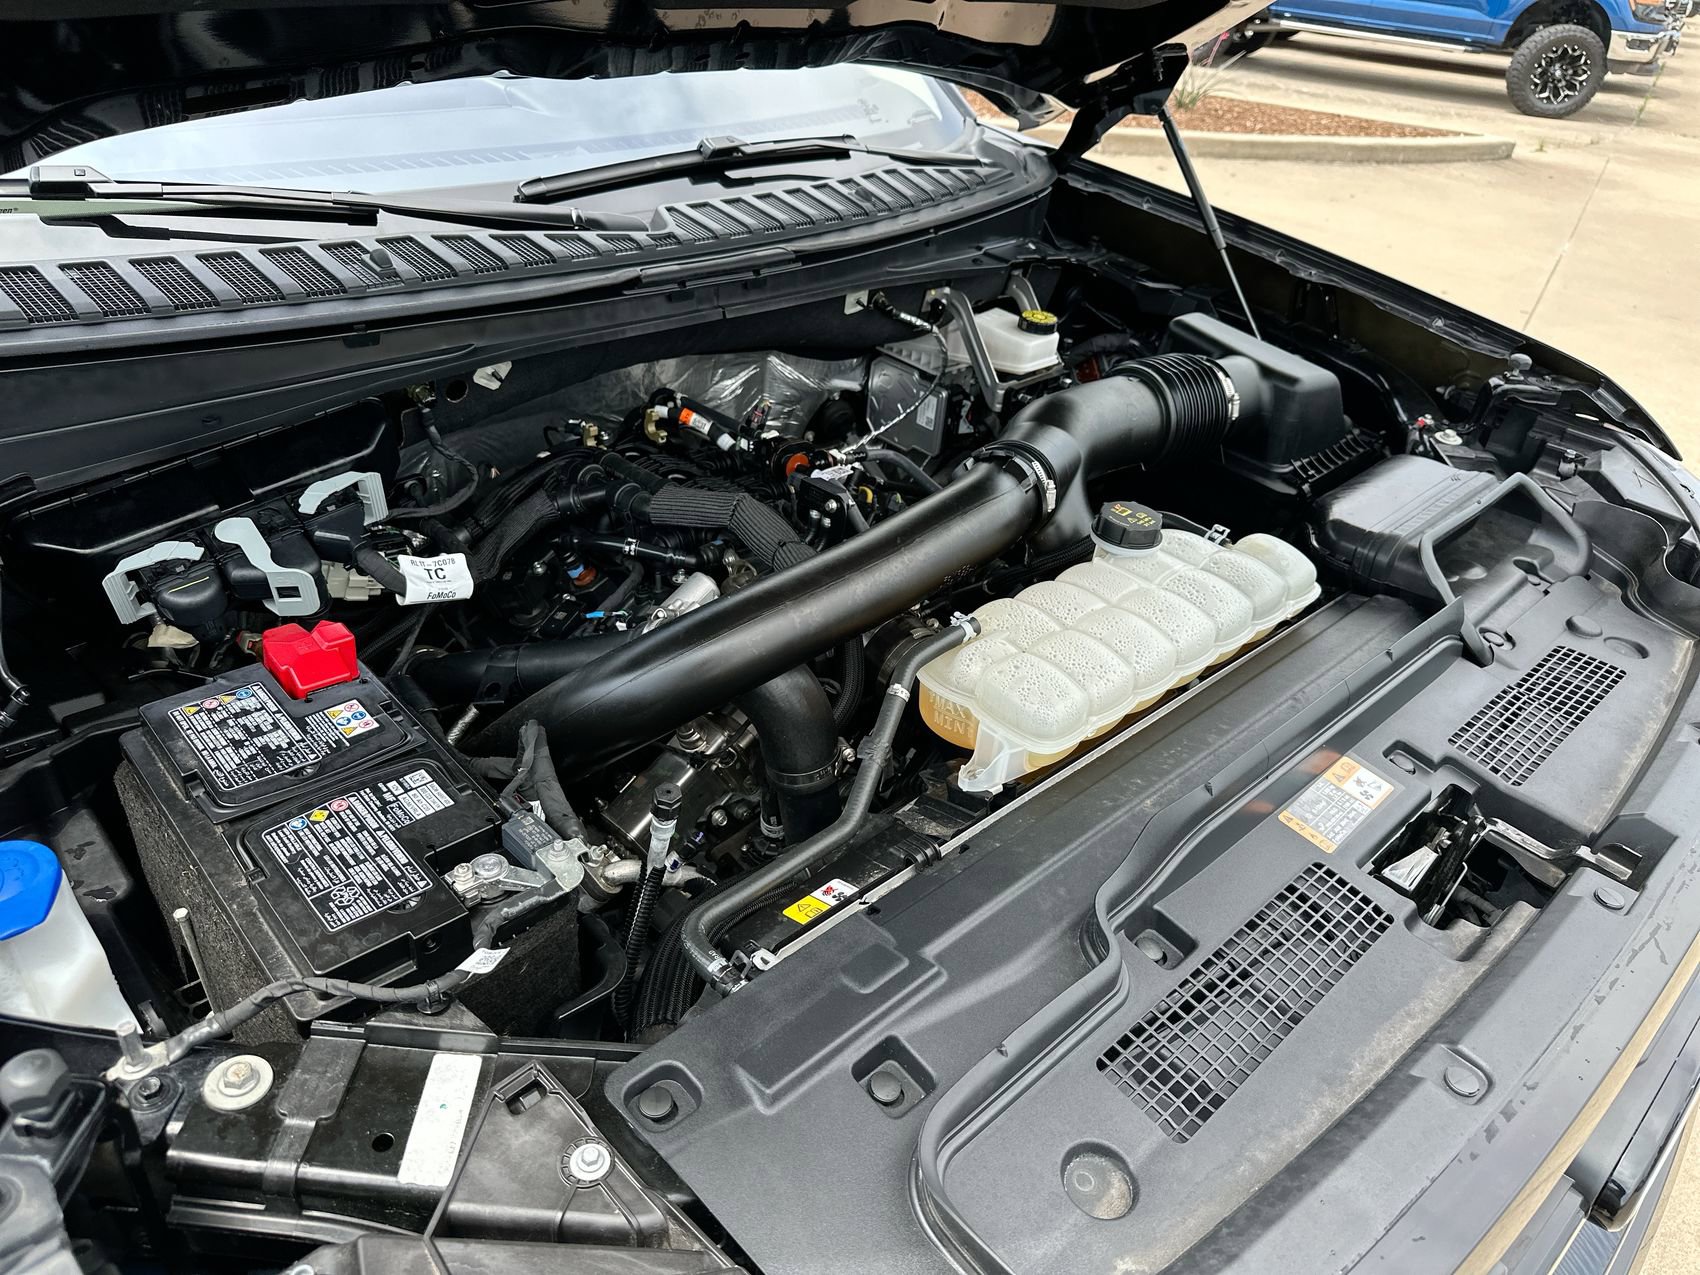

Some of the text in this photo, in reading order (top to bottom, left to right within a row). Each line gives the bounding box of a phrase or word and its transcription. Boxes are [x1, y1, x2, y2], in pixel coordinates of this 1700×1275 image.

[424, 568, 446, 580] TC
[427, 591, 457, 600] FoMoCo
[934, 695, 966, 719] MAX
[934, 711, 966, 735] MIN
[389, 804, 410, 824] FoMoCo
